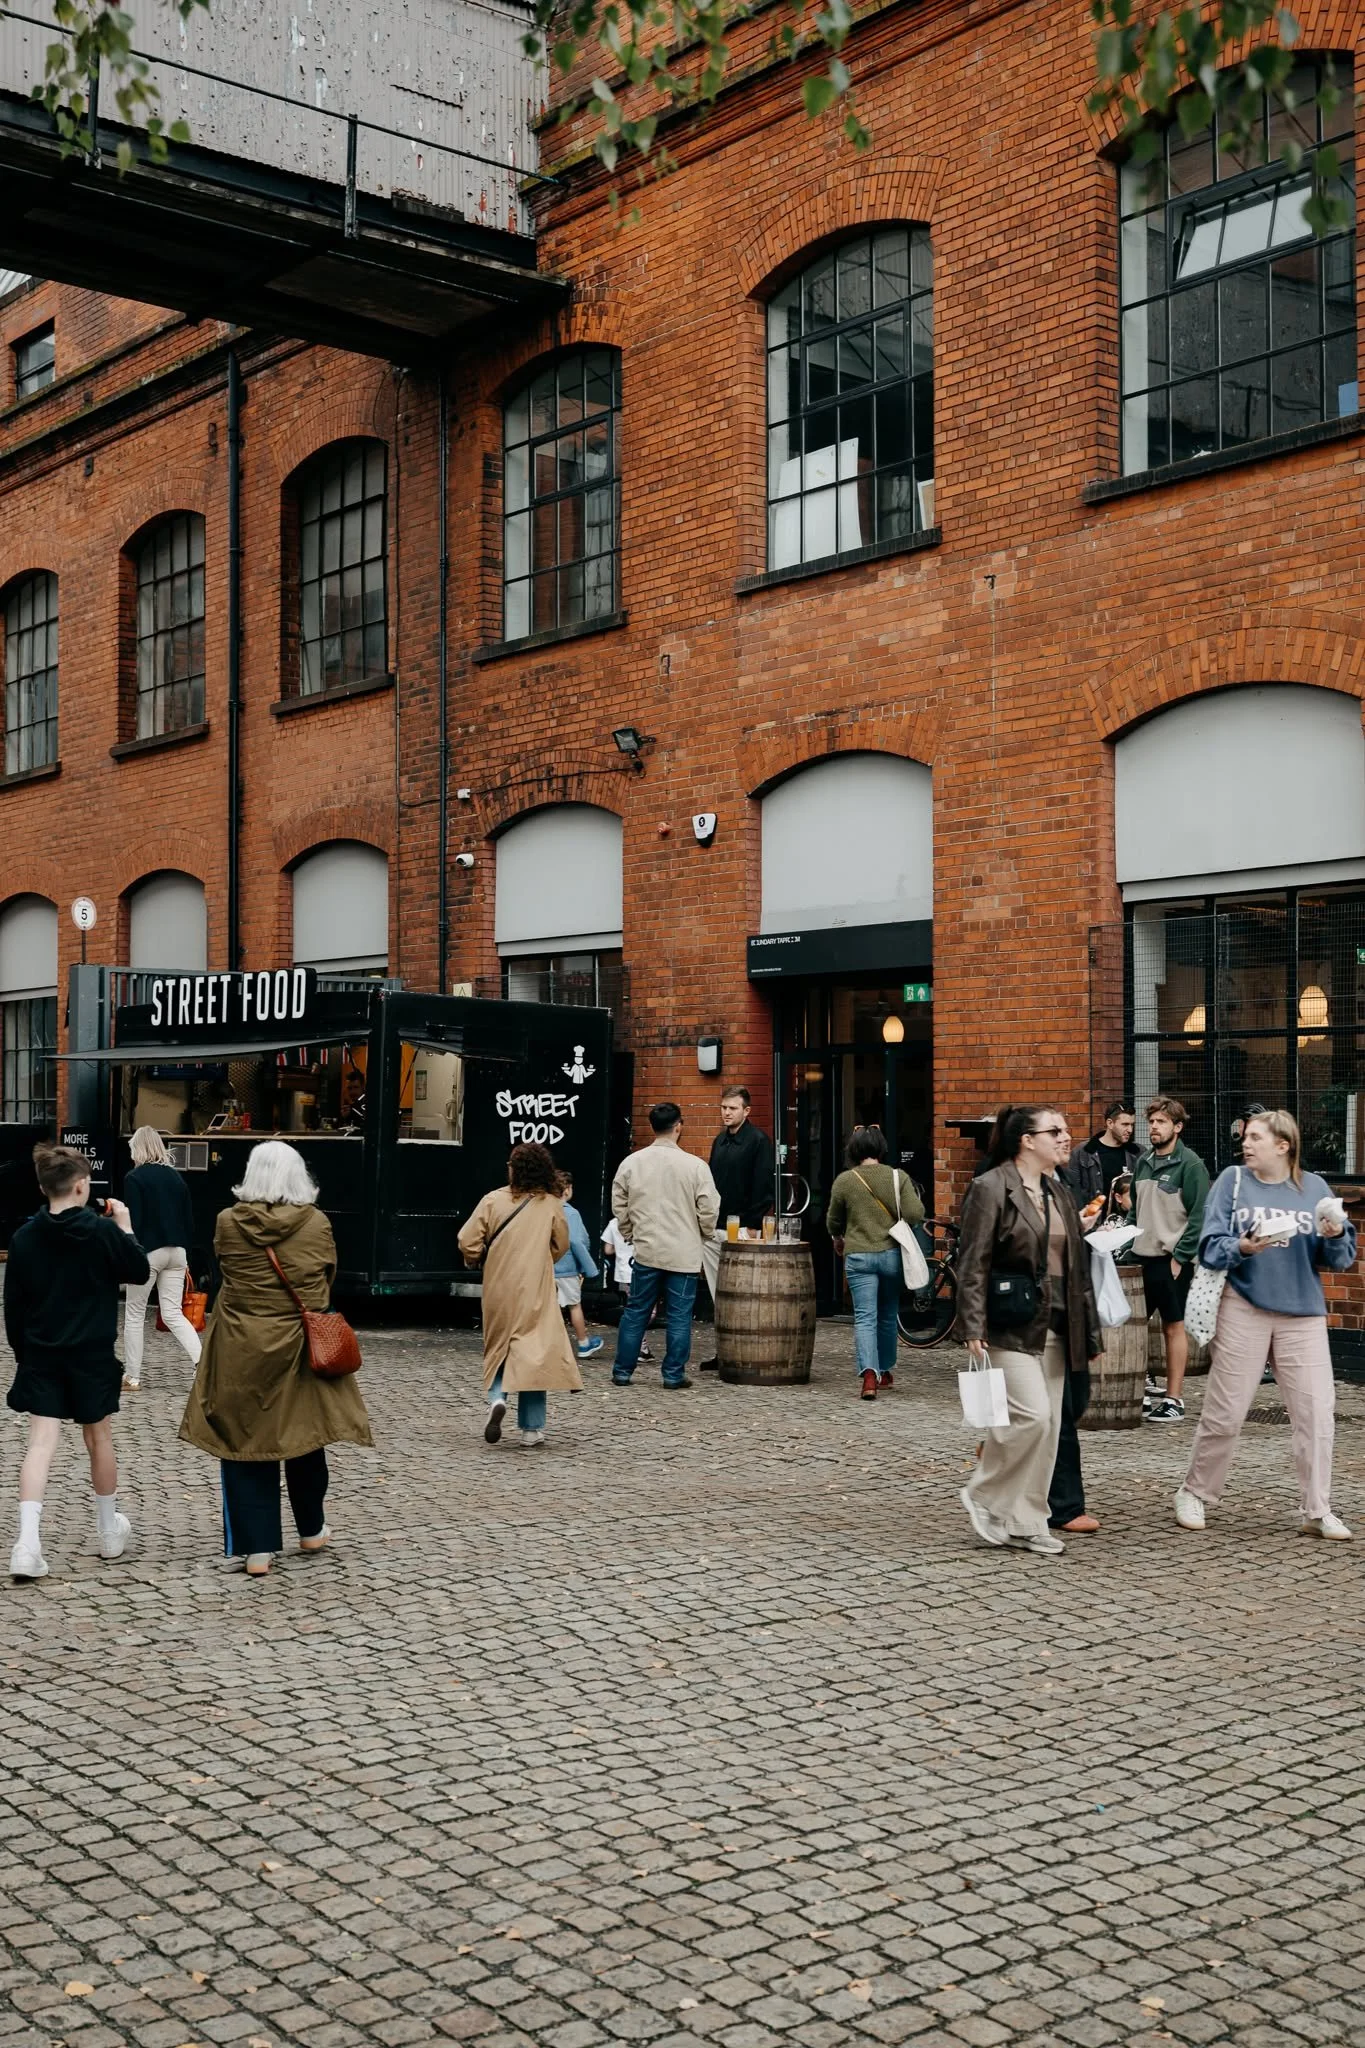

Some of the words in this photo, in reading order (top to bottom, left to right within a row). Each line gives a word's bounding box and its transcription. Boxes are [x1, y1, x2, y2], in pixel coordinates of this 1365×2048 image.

[81, 908, 88, 921] 5
[151, 974, 231, 1026] STREET
[242, 968, 306, 1022] FOOD
[495, 1089, 579, 1118] STREET
[63, 1133, 89, 1144] MORE
[509, 1121, 564, 1145] FOOD
